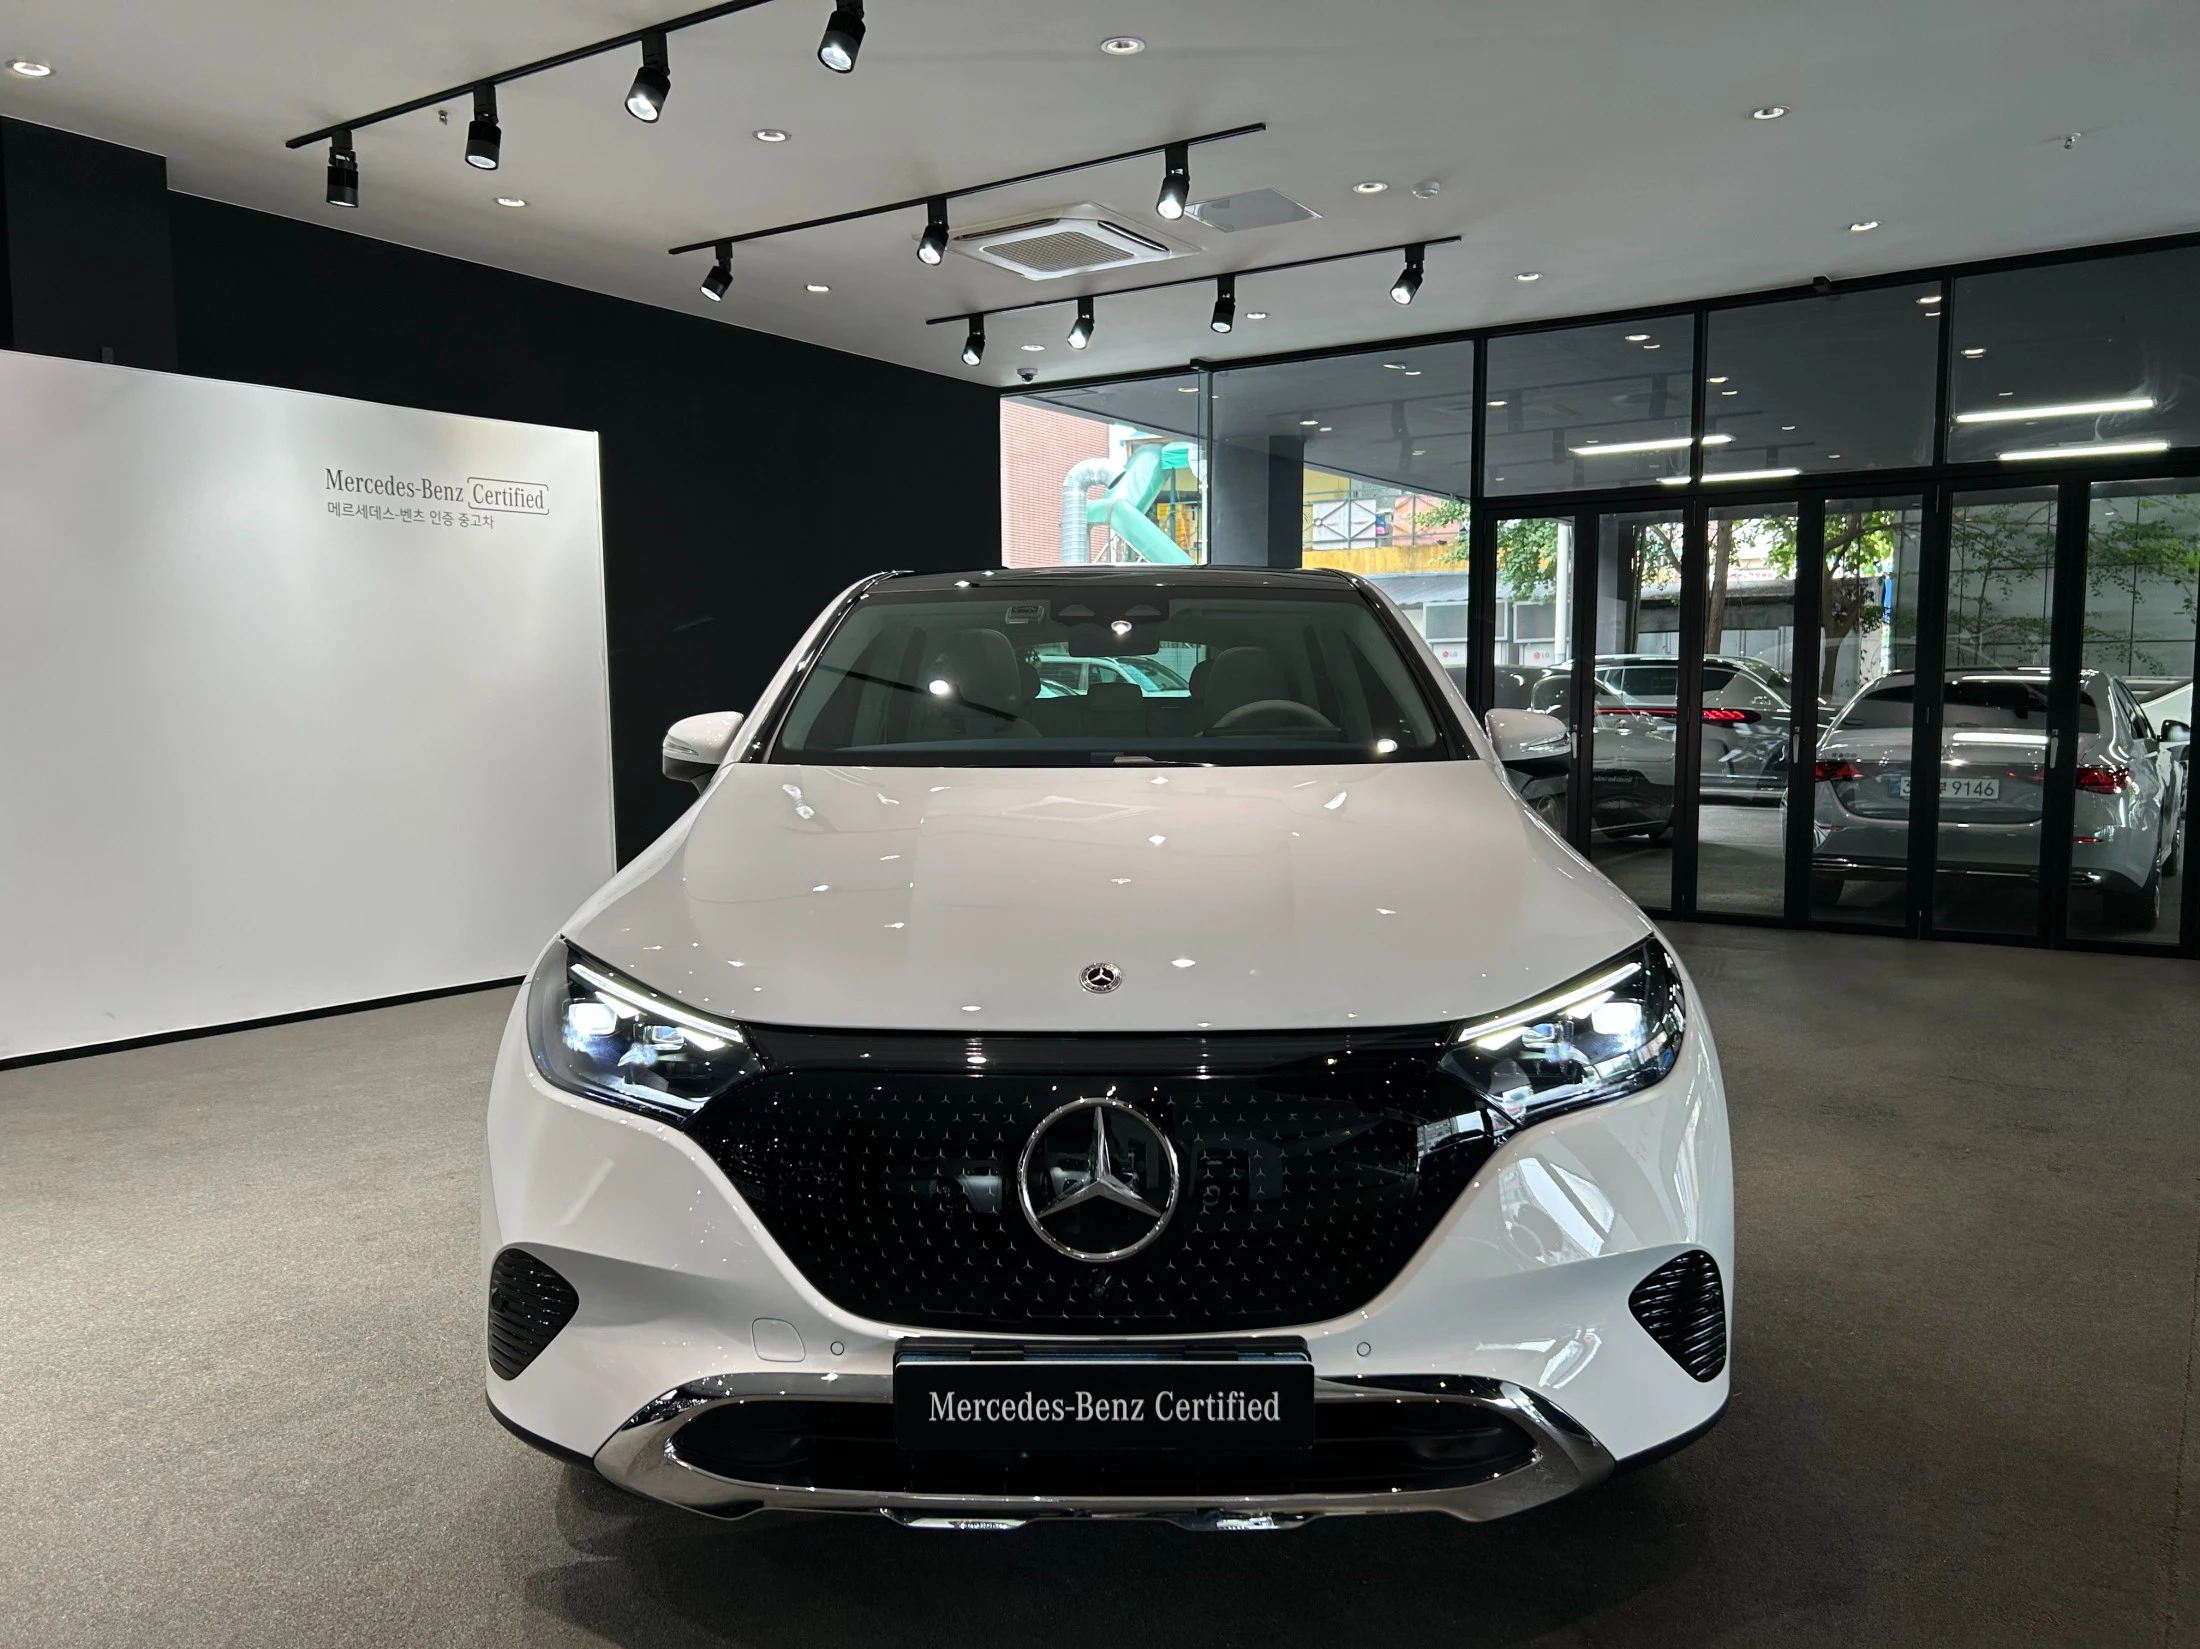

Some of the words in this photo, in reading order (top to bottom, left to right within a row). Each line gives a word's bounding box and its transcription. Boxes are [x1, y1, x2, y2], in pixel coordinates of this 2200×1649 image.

[325, 467, 464, 502] Mercedes-Benz
[472, 482, 545, 509] Certified
[327, 501, 426, 523] 메르세데스-벤츠
[429, 510, 454, 527] 인증
[458, 512, 495, 530] 중고차
[1952, 780, 1994, 796] 9146
[928, 1390, 1144, 1422] Mercedes-Benz
[1155, 1390, 1282, 1422] Certified
